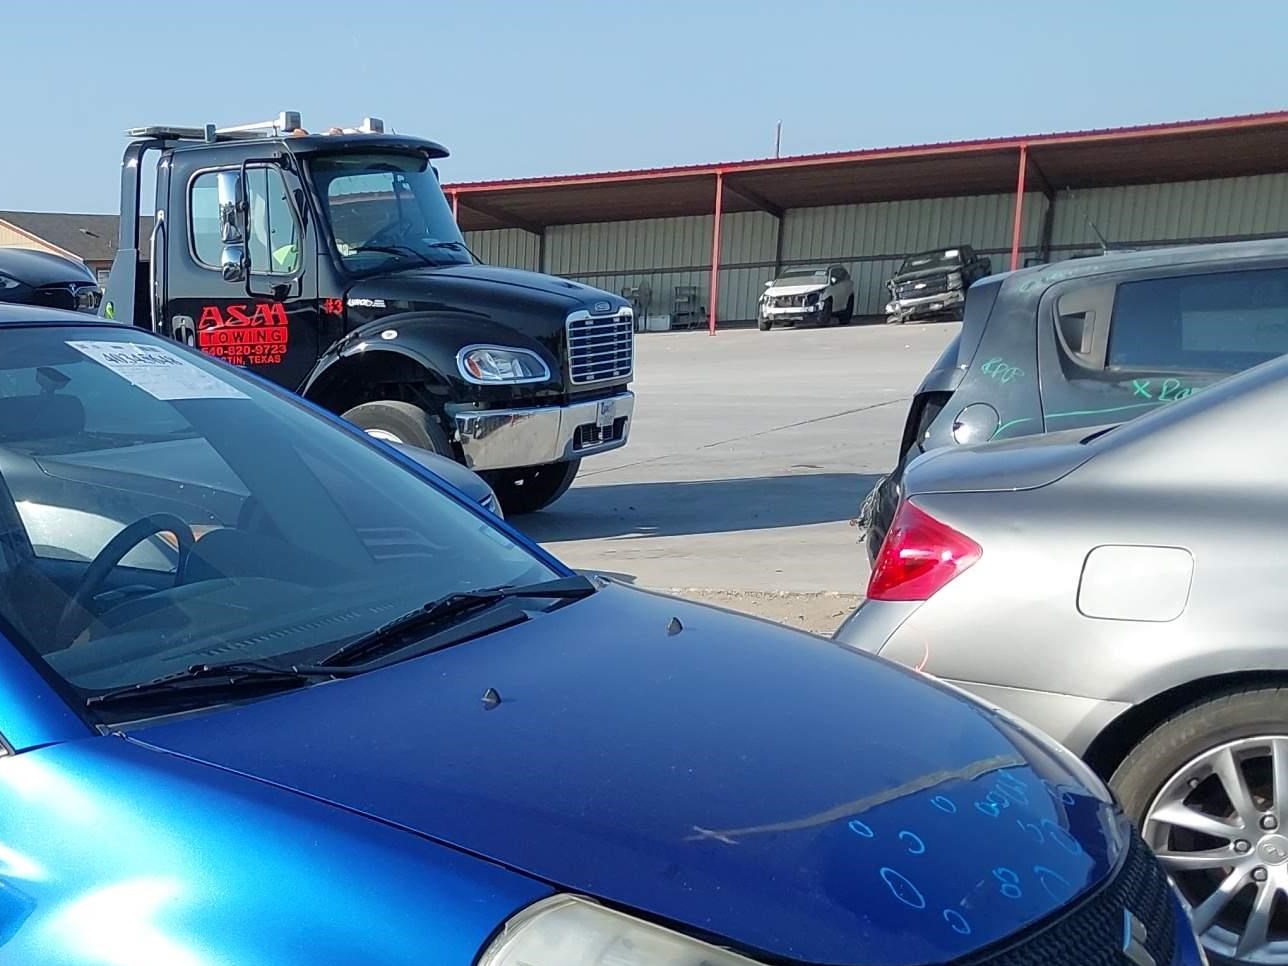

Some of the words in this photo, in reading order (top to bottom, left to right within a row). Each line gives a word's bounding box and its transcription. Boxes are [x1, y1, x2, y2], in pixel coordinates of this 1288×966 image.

[325, 298, 344, 315] #3
[198, 303, 288, 327] ASM
[206, 330, 282, 343] TOWING
[248, 354, 281, 364] TEXAS
